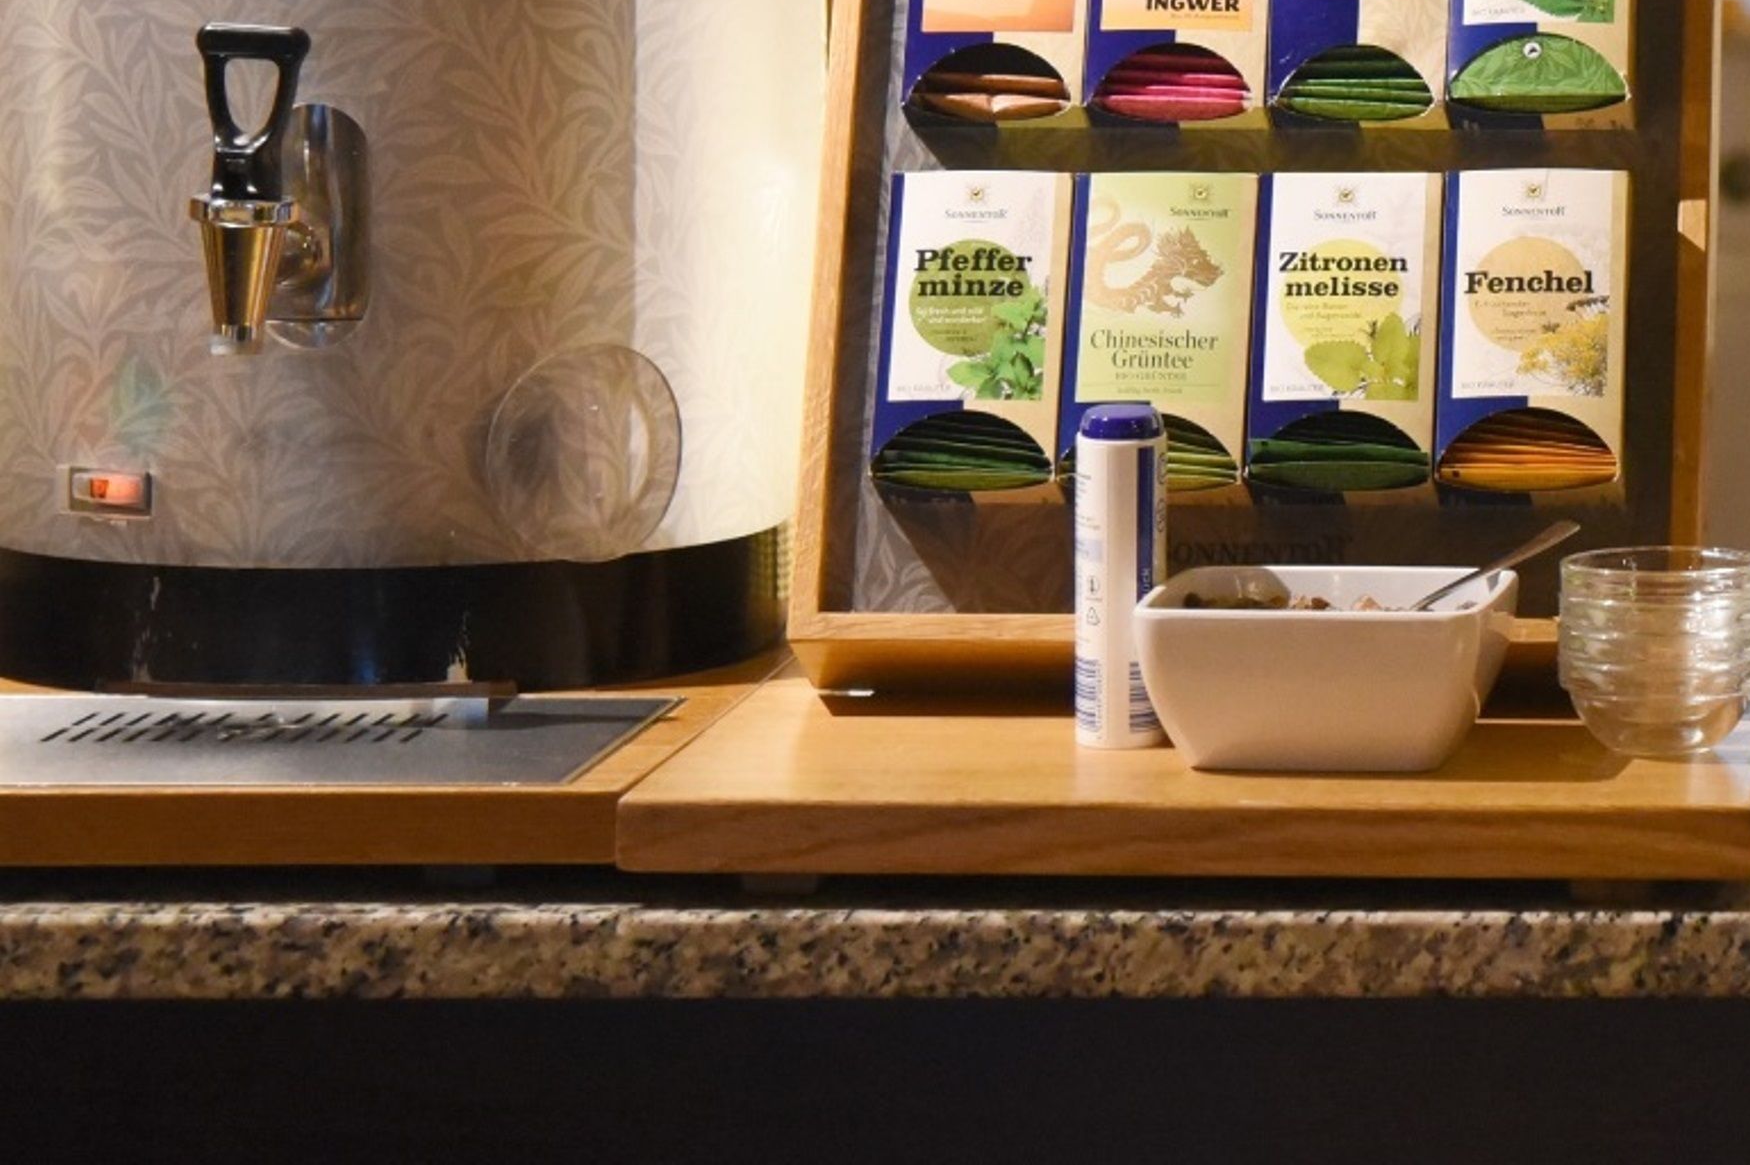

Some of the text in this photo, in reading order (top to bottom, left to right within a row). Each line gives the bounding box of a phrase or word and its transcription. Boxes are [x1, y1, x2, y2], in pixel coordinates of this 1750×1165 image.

[914, 248, 1033, 273] Pfeffer
[1279, 251, 1408, 273] Zitronen
[917, 273, 1025, 297] minze
[1285, 275, 1400, 297] melisse
[1463, 270, 1594, 295] Fenchel
[1090, 329, 1219, 351] Chinesischer
[1111, 350, 1194, 370] Grüntee
